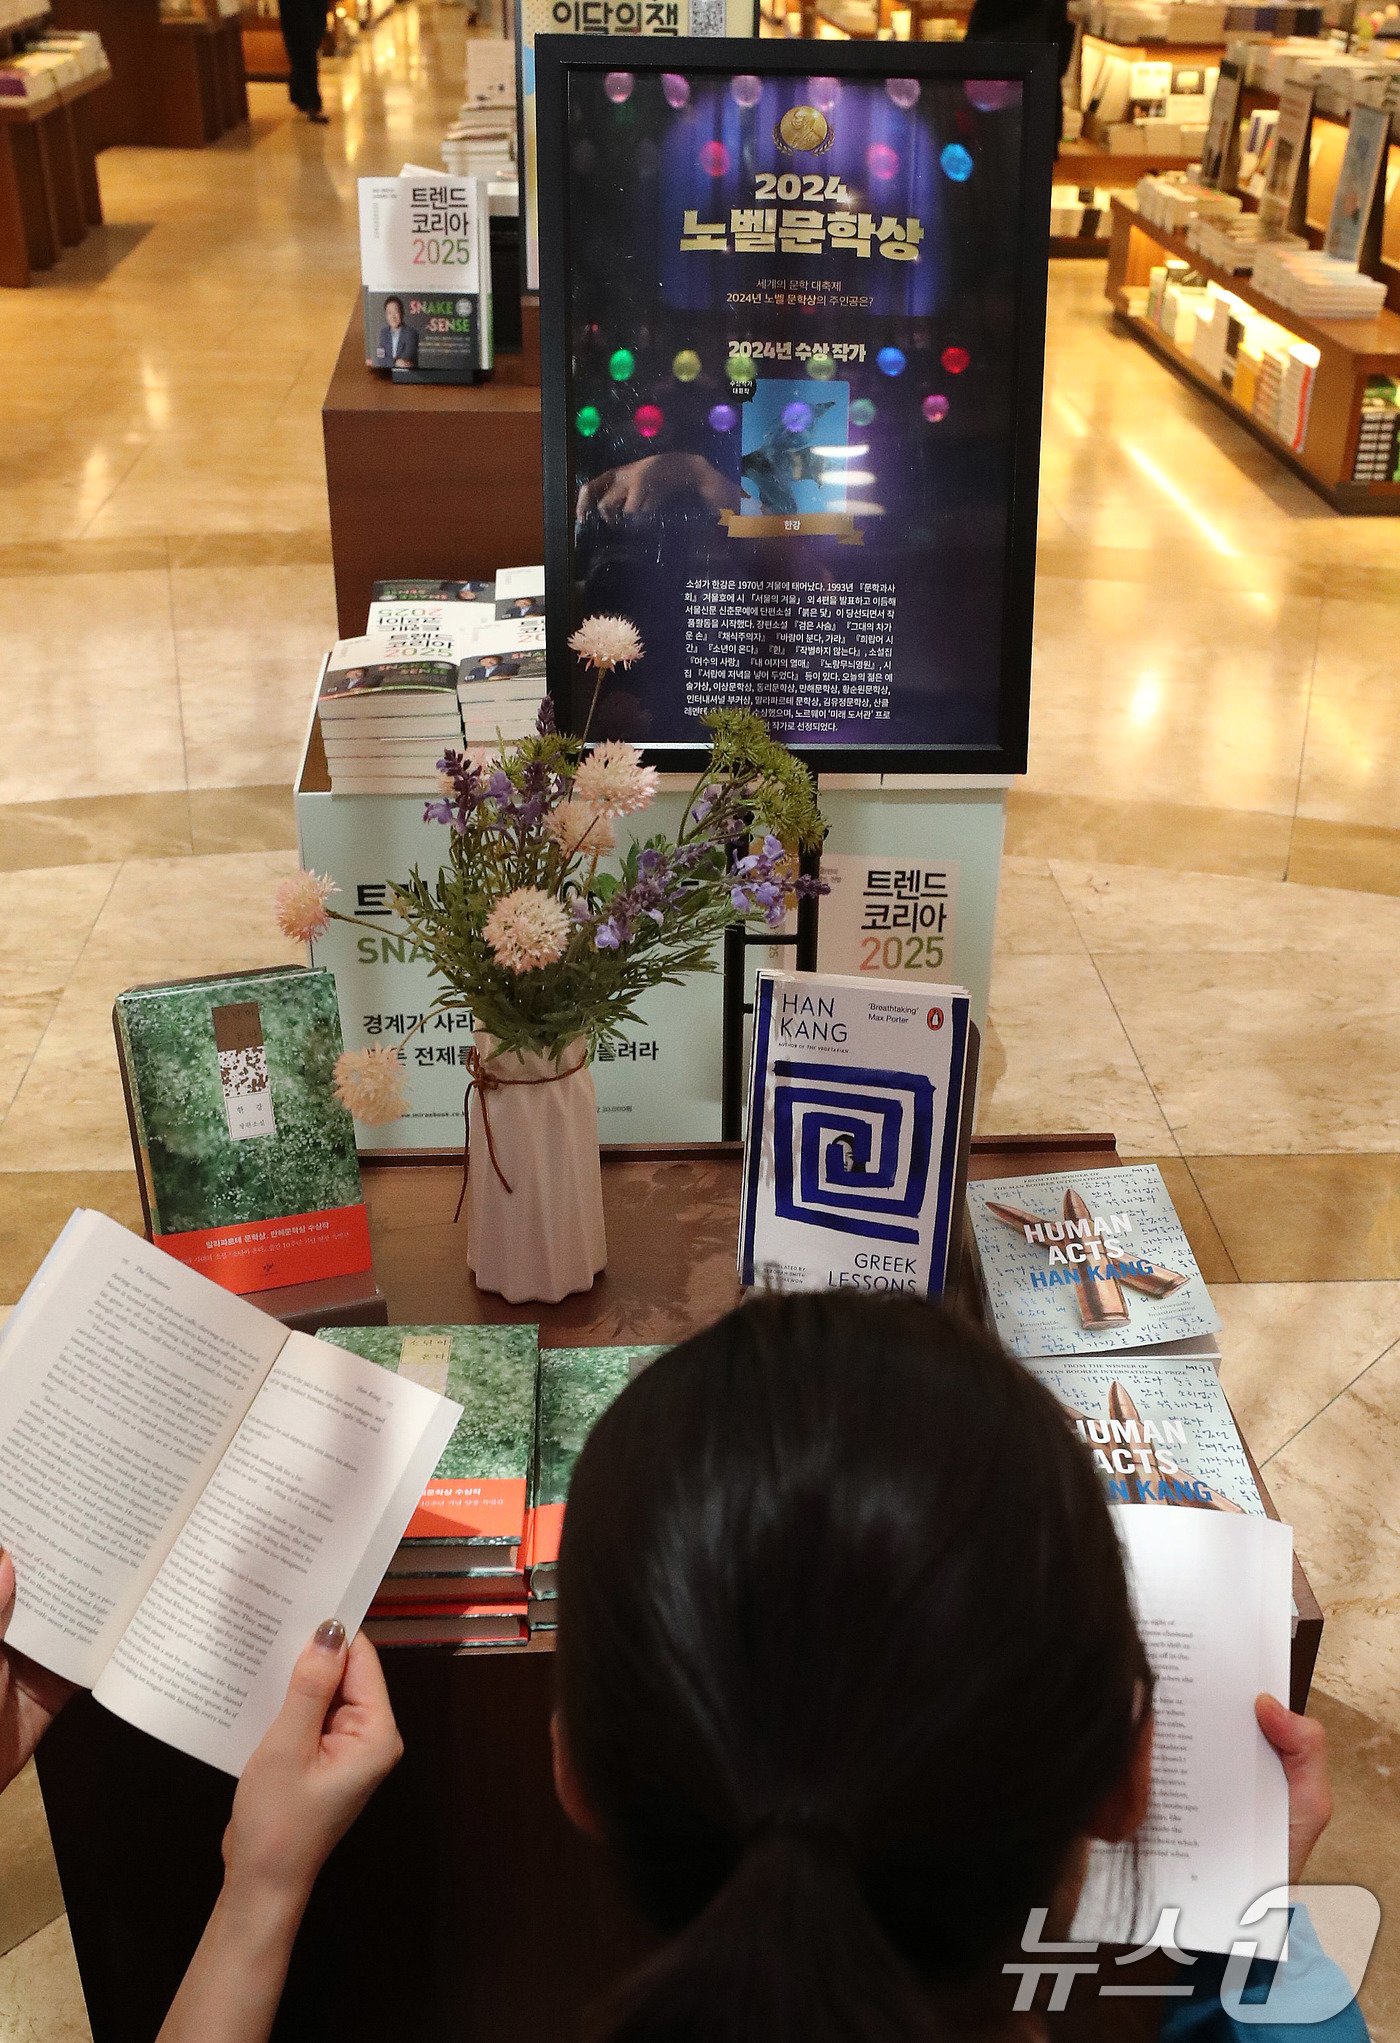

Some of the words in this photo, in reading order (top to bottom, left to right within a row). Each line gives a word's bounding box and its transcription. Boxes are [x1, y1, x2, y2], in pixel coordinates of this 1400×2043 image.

[411, 186, 468, 210] 트렌드
[755, 173, 852, 203] 2024
[412, 212, 469, 236] 코리아
[680, 208, 924, 261] 노벨문학상
[412, 238, 469, 264] 2025
[789, 280, 808, 291] 문학
[811, 280, 842, 292] 대축제
[727, 293, 762, 304] 2024년
[765, 293, 784, 305] 노벨
[787, 294, 827, 306] 문학상의
[829, 296, 873, 307] 주인공은?
[728, 341, 792, 361] 2024년
[795, 343, 829, 361] 수상
[832, 344, 866, 362] 작가
[784, 520, 800, 531] 한강
[686, 579, 709, 590] 소설가
[711, 579, 735, 591] 한강은
[738, 581, 764, 591] 1970년
[766, 581, 790, 591] 겨울에
[792, 582, 825, 592] 태어났다.
[827, 582, 854, 593] 1993년
[703, 593, 735, 603] 겨울호에
[737, 594, 745, 603] 시
[751, 593, 779, 604] 「서울의
[781, 595, 800, 605] 겨울」
[807, 596, 815, 605] 외
[816, 596, 838, 605] 4편을
[839, 596, 871, 606] 발표하고
[872, 597, 897, 607] 이듬해
[685, 605, 717, 615] 서울신문
[719, 606, 758, 616] 신춘문예에
[760, 607, 792, 617] 단편소설
[836, 608, 844, 618] 이
[846, 609, 885, 619] 당선되면서
[887, 610, 895, 619] 작
[721, 619, 755, 629] 시작했다.
[757, 620, 788, 630] 장편소설
[846, 621, 874, 632] 『그대의
[876, 622, 892, 632] 차가
[685, 630, 693, 641] 운
[717, 631, 766, 642] 『채식주의자』
[776, 632, 804, 643] 『바람이
[806, 633, 824, 644] 분다,
[825, 634, 846, 644] 가라』
[885, 635, 894, 645] 시
[708, 643, 736, 654] 『소년이
[738, 644, 758, 655] 온다』
[795, 645, 831, 656] 『작별하지
[869, 647, 893, 657] 소설집
[720, 657, 740, 667] 사랑』
[750, 657, 762, 667] 『내
[764, 658, 788, 668] 여자의
[884, 660, 892, 670] 시
[684, 669, 692, 679] 집
[728, 670, 751, 680] 저녁을
[753, 670, 769, 680] 넣어
[771, 671, 799, 681] 두었다』
[805, 671, 820, 682] 등이
[822, 672, 840, 682] 있다.
[842, 672, 865, 682] 오늘의
[867, 673, 883, 683] 젊은
[884, 673, 893, 683] 예
[686, 681, 711, 692] 술가상,
[713, 682, 755, 693] 이상문학상,
[757, 683, 797, 694] 동리문학상,
[799, 684, 841, 695] 만해문학상,
[842, 685, 891, 696] 황순원문학상,
[686, 694, 726, 705] 인터내셔널
[727, 695, 753, 706] 부커상,
[755, 696, 794, 706] 말라파르테
[796, 697, 822, 707] 문학상,
[823, 697, 872, 708] 김유정문학상,
[873, 698, 889, 708] 산클
[795, 709, 827, 719] 노르웨이
[874, 711, 891, 720] 프로
[772, 721, 795, 731] 작가로
[797, 722, 838, 732] 선정되었다.
[863, 869, 948, 901] 트렌드
[861, 903, 947, 933] 코리아
[357, 937, 433, 964] SNA
[860, 936, 944, 971] 2025
[783, 993, 835, 1018] HAN
[363, 1013, 426, 1035] 경계가
[434, 1013, 475, 1034] 사라
[868, 1013, 884, 1022] Max
[886, 1015, 909, 1024] Porter
[781, 1017, 848, 1043] KANG
[1023, 1212, 1133, 1244] HUMAN
[1048, 1238, 1125, 1266] ACTS
[854, 1253, 917, 1275] GREEK
[1031, 1266, 1080, 1290] HAN
[1088, 1258, 1155, 1281] KANG
[829, 1271, 917, 1293] LESSONS
[1093, 1448, 1180, 1475] ACTS
[1136, 1479, 1213, 1503] KANG
